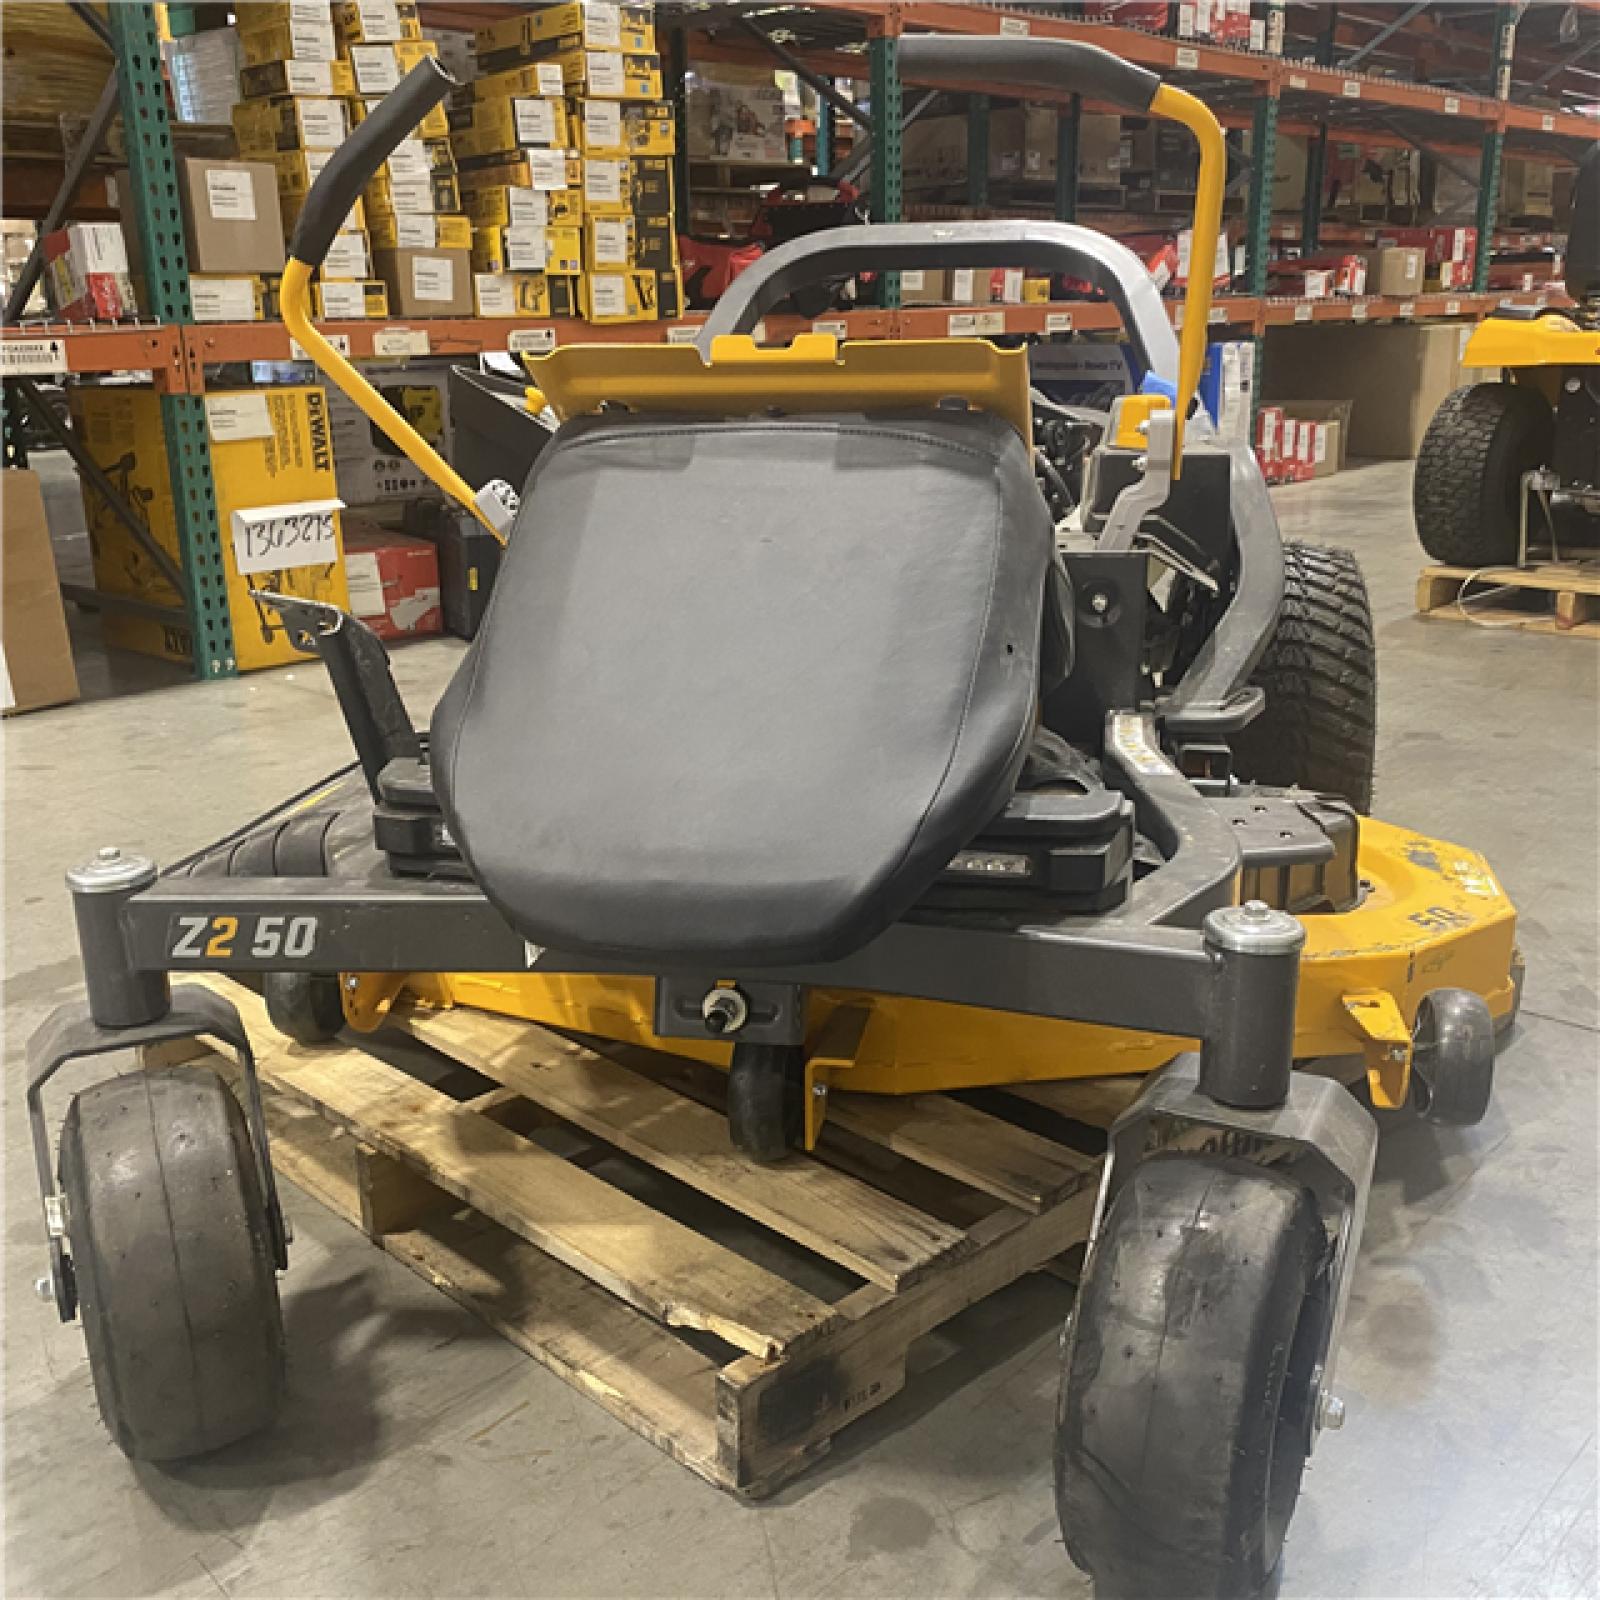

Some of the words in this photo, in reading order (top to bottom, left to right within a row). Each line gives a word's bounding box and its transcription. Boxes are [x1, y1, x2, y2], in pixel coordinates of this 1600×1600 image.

[307, 392, 331, 472] DEWALT
[172, 917, 238, 957] Z2
[252, 917, 318, 957] 50
